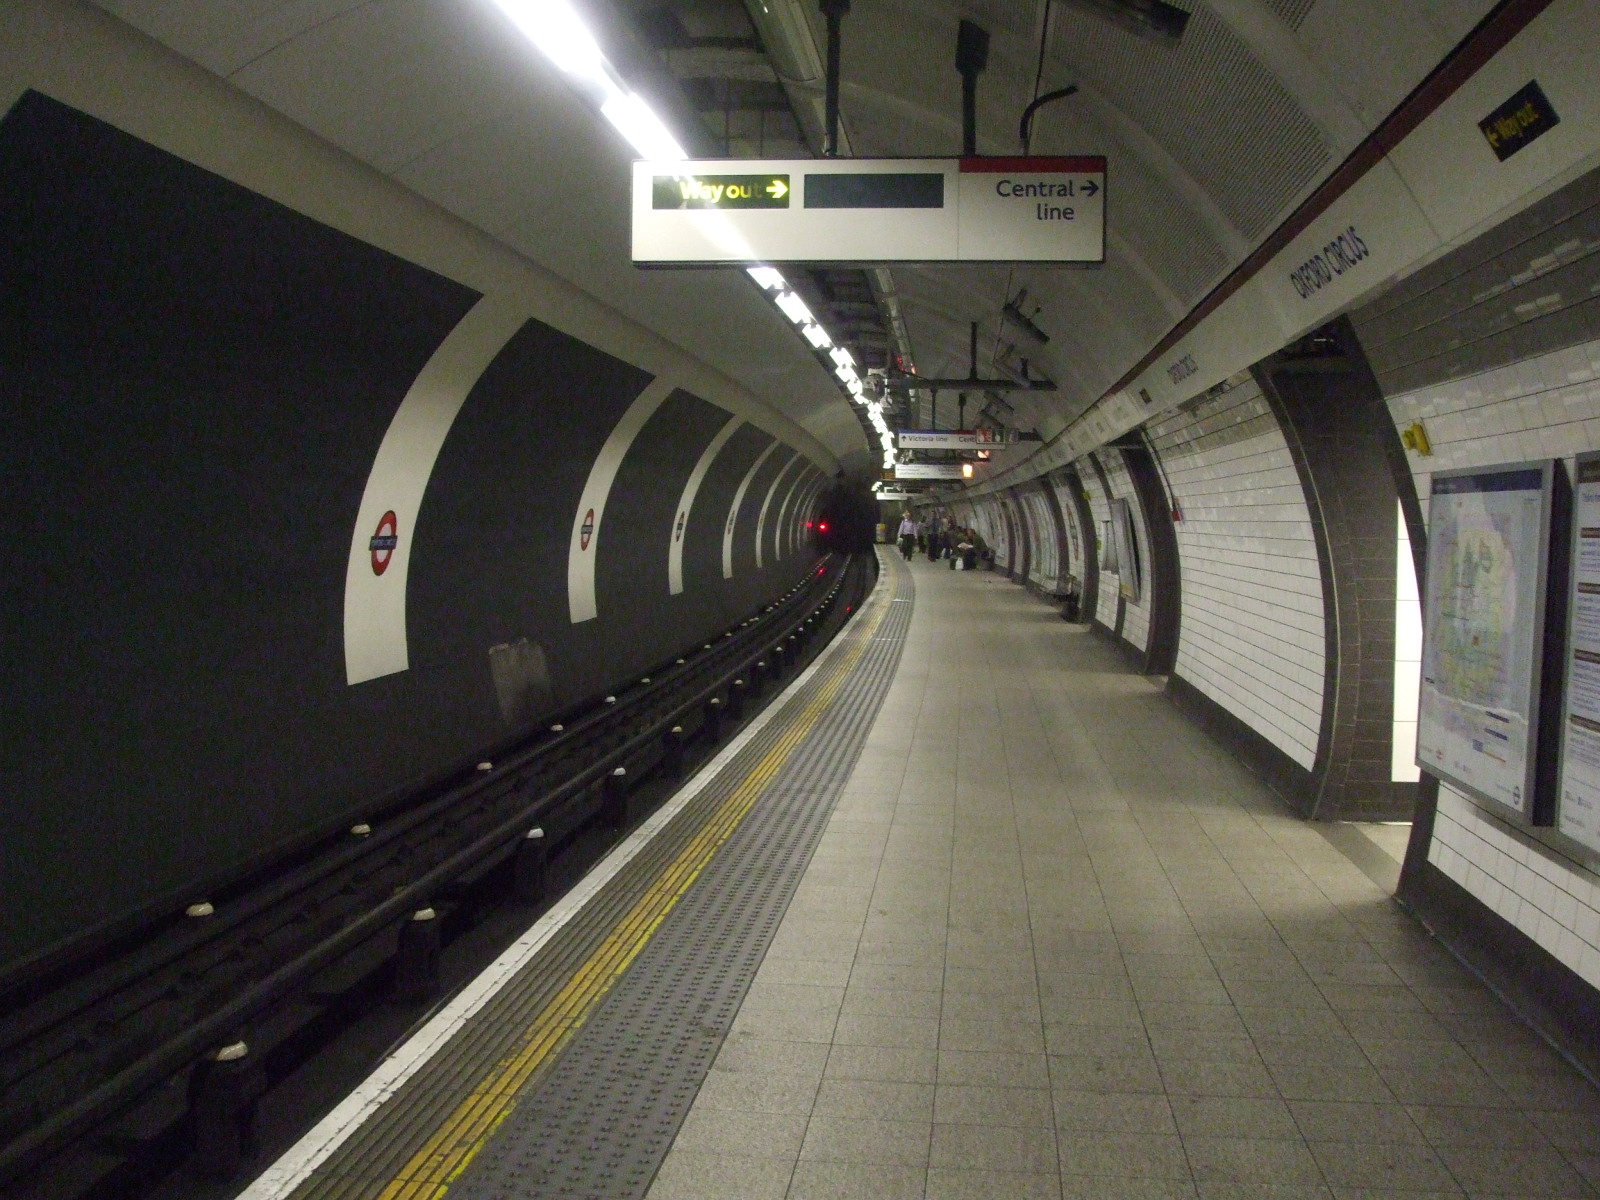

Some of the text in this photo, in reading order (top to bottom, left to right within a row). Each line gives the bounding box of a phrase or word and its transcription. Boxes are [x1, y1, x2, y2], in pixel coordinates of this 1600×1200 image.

[680, 180, 762, 204] Way out
[996, 180, 1075, 198] Central
[1037, 203, 1075, 220] line
[1290, 225, 1370, 299] OXFORD CIRCUS
[908, 435, 934, 443] Victoria
